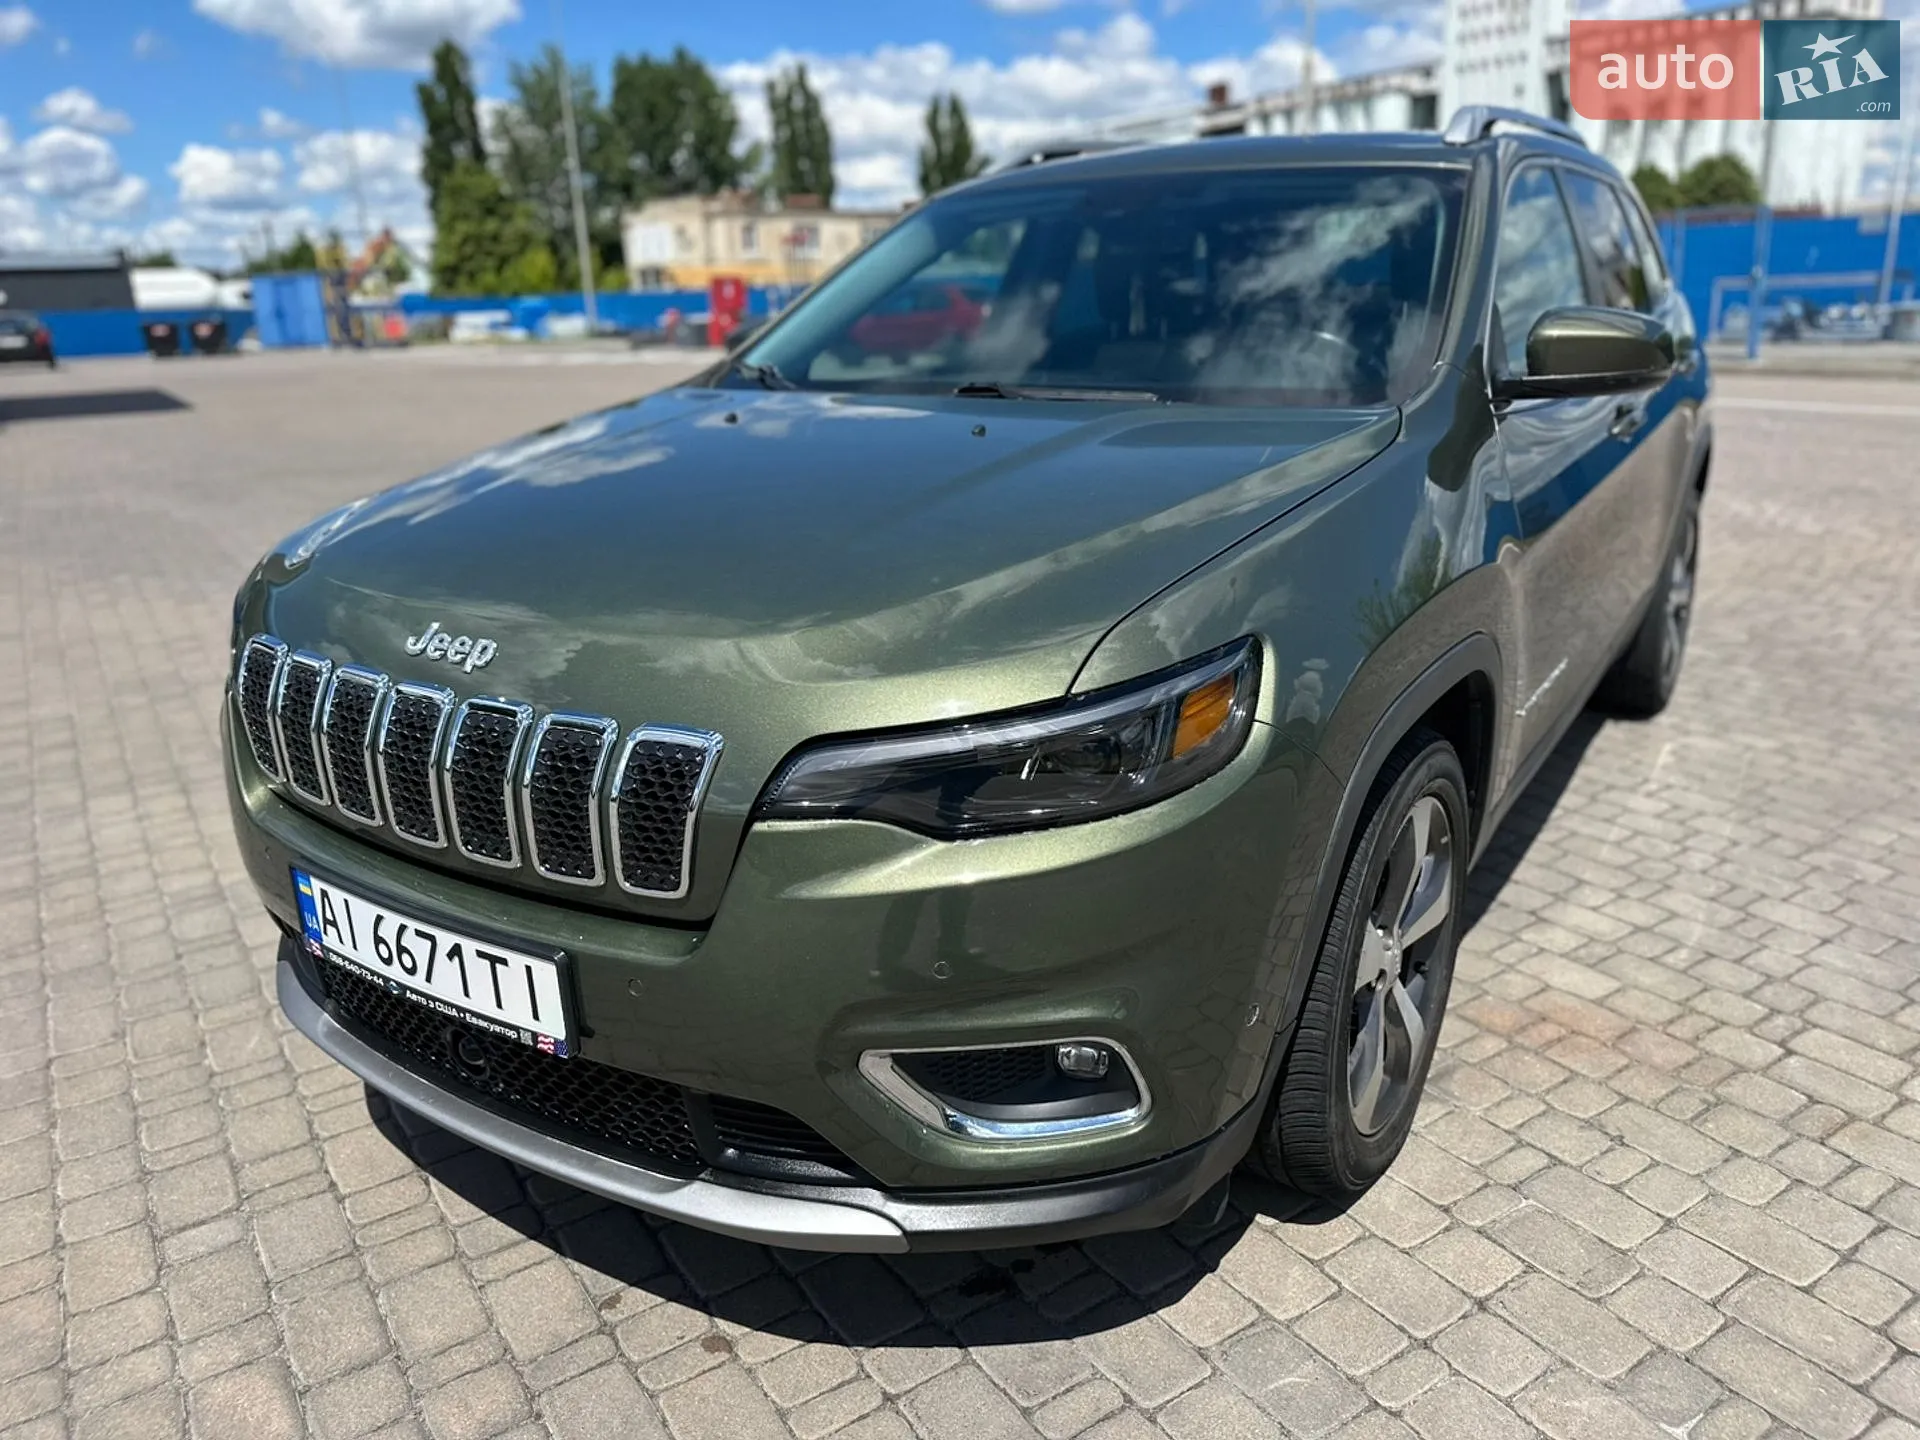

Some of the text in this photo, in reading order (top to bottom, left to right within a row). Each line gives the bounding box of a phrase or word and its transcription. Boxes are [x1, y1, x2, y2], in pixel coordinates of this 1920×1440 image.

[404, 622, 498, 674] Jeep
[304, 911, 320, 932] UA
[320, 887, 358, 952] AI
[406, 989, 428, 1005] Авто
[435, 1001, 460, 1018] США
[465, 1012, 519, 1039] Евакуатор
